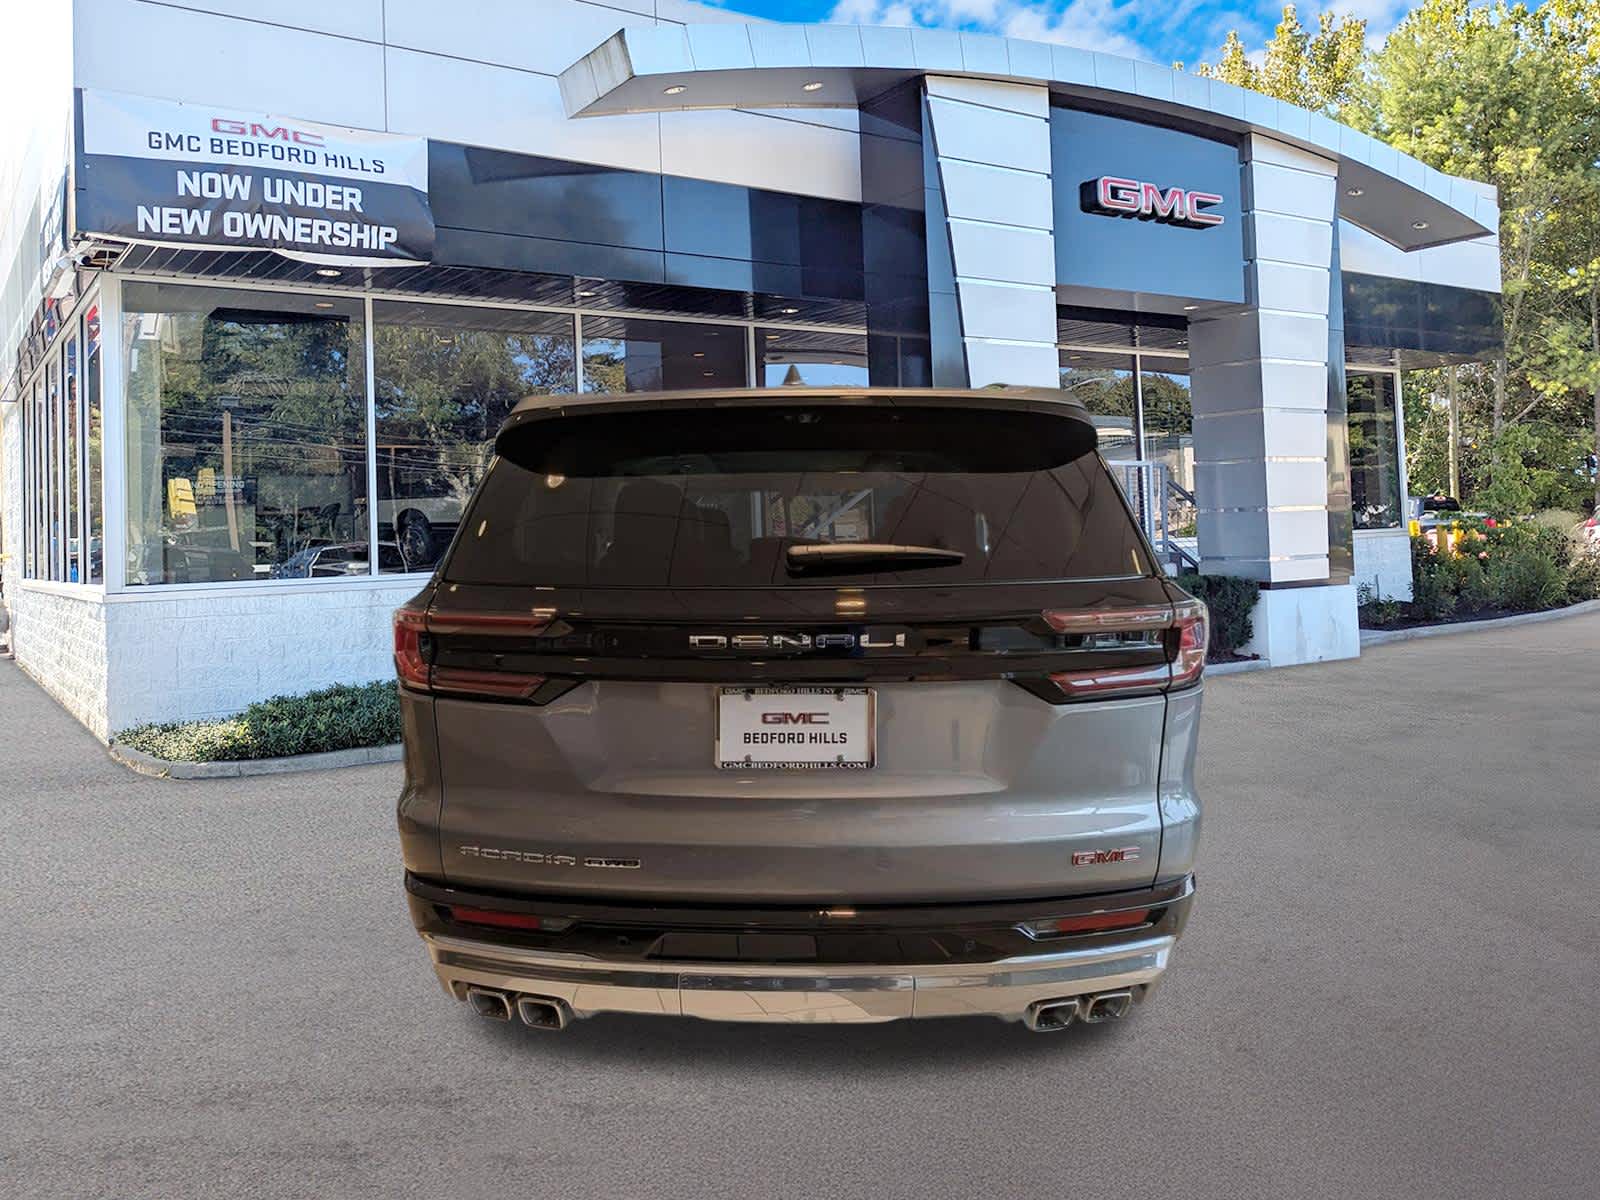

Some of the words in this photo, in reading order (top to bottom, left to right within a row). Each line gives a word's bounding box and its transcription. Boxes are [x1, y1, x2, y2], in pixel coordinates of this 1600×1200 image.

[211, 117, 326, 147] GMC
[147, 131, 202, 153] GMC
[209, 138, 317, 166] BEDFORD
[325, 154, 385, 175] HILLS
[176, 170, 252, 201] NOW
[263, 177, 364, 213] UNDER
[1094, 175, 1225, 226] GMC
[136, 205, 212, 237] NEW
[223, 211, 398, 251] OWNERSHIP
[688, 633, 906, 649] DENALI
[761, 712, 830, 725] GMC
[743, 732, 805, 744] BEDFORD
[809, 732, 848, 744] HILLS
[1071, 846, 1142, 867] GMC
